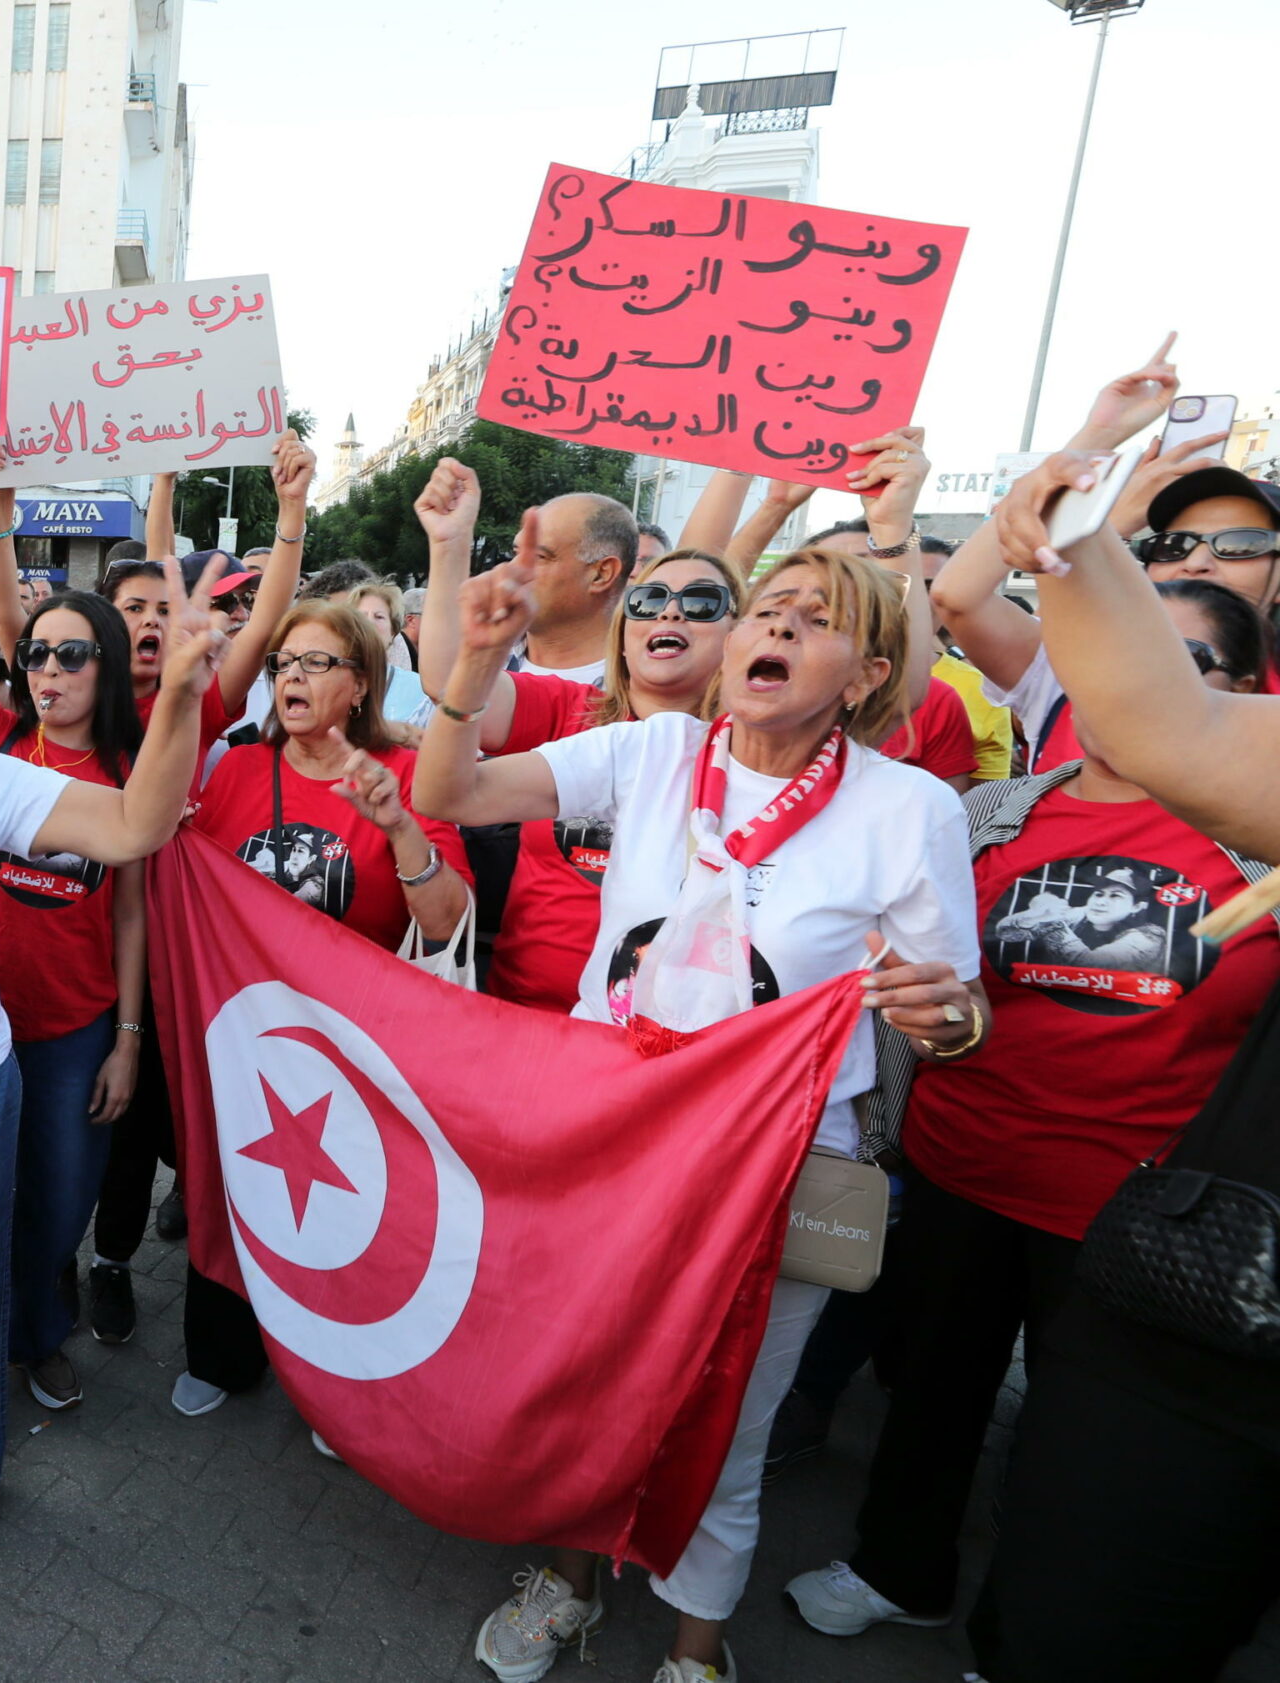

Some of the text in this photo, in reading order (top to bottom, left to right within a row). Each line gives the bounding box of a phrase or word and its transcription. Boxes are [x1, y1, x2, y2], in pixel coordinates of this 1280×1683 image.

[743, 220, 941, 285] وينو
[106, 298, 170, 329] من
[188, 284, 265, 333] يزي
[738, 297, 912, 353] وينو
[92, 345, 203, 388] بحق
[755, 363, 882, 415] وين
[91, 413, 121, 462] في
[753, 421, 849, 474] وين
[33, 502, 103, 521] MAYA
[42, 524, 93, 534] CAFÉ RESTO
[27, 569, 51, 577] MAYA
[789, 1211, 871, 1241] Klein Jeans
